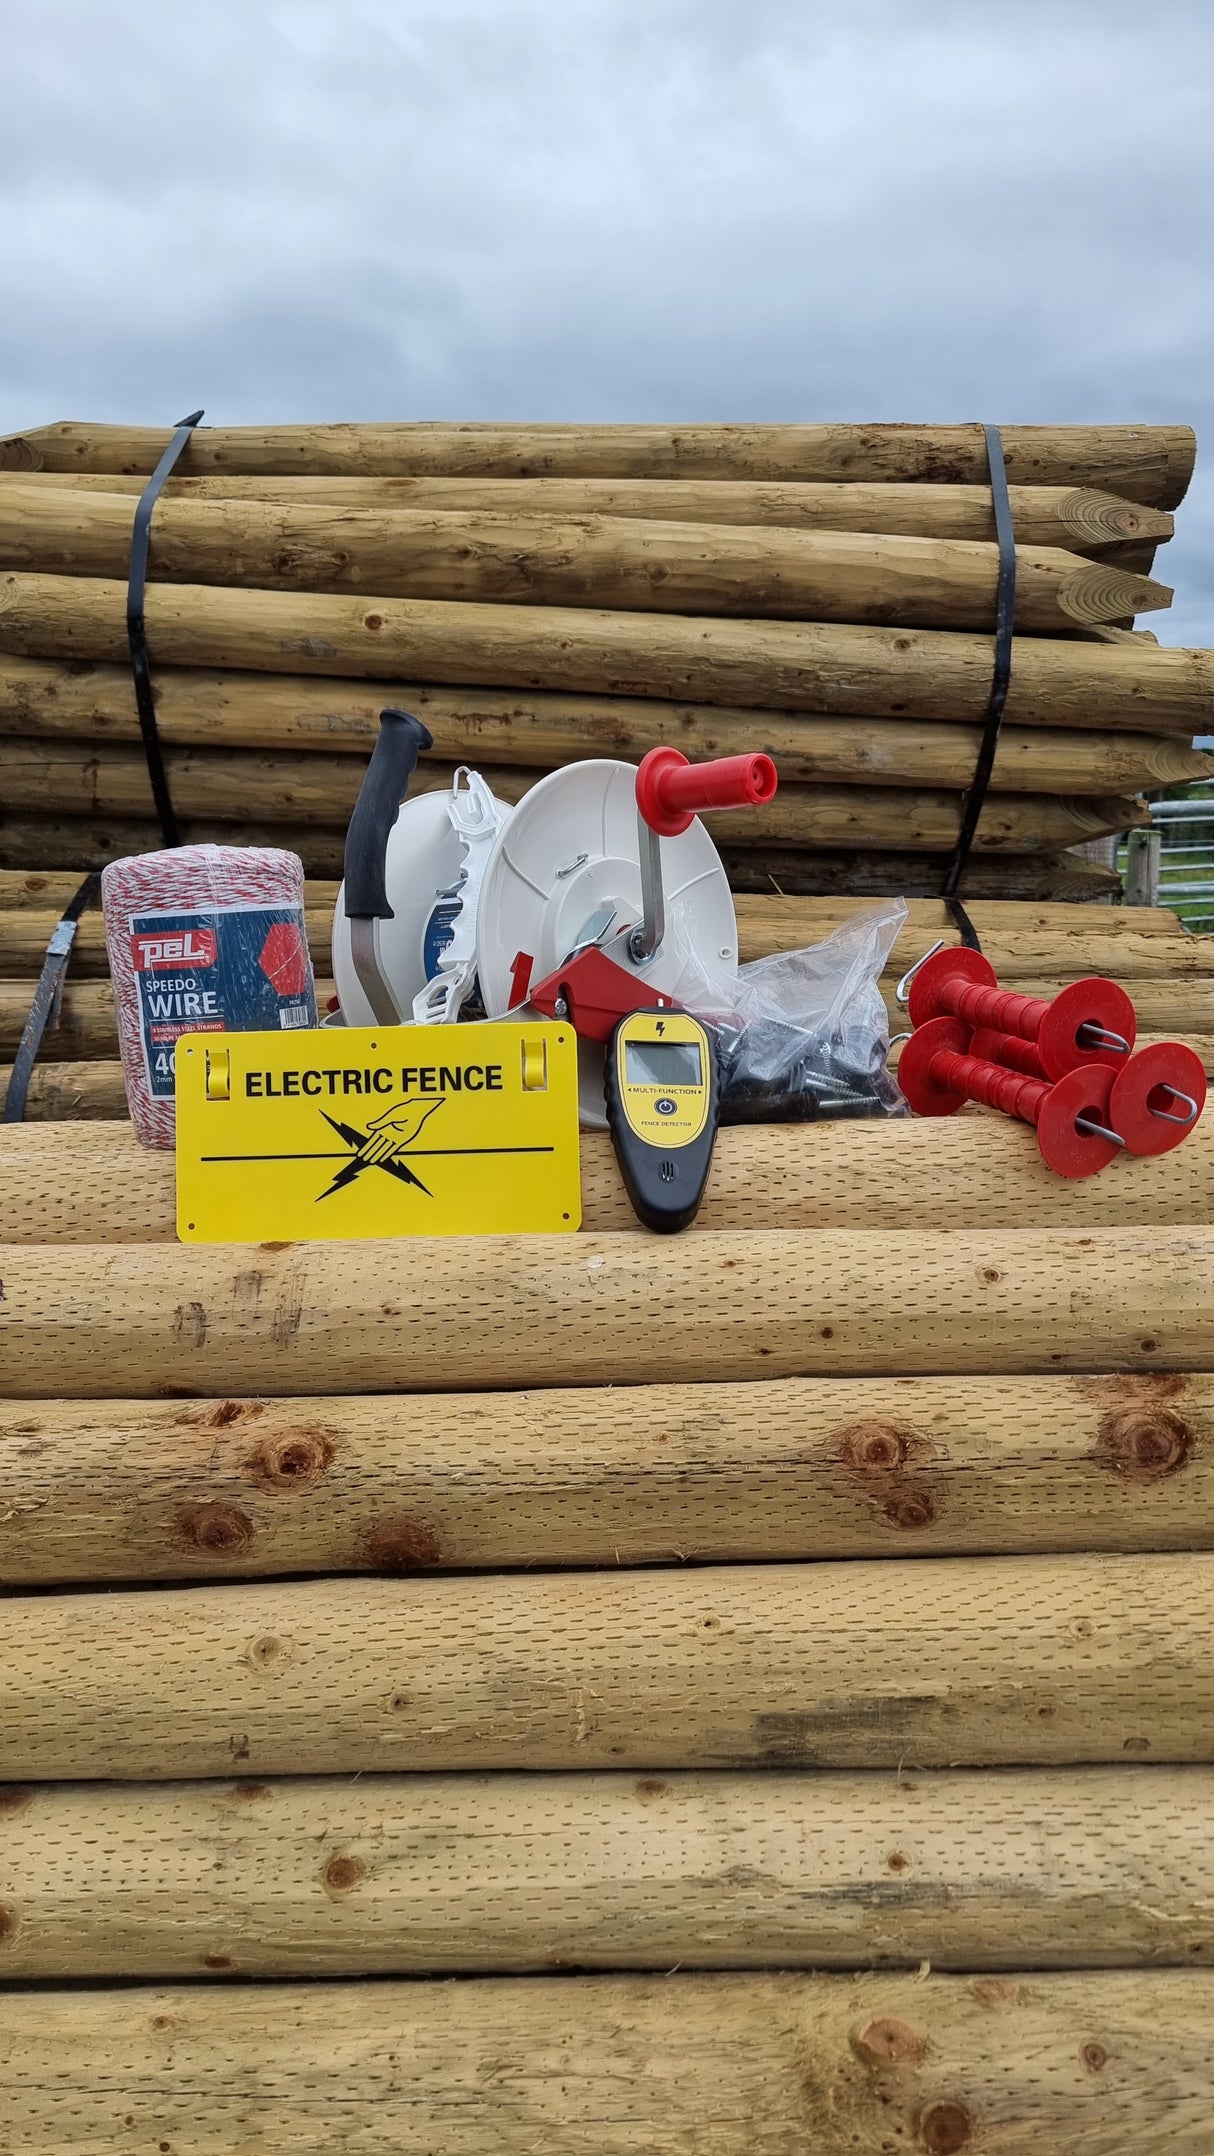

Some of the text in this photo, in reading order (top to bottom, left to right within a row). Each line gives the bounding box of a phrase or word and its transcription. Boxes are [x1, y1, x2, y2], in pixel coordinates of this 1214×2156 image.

[146, 979, 196, 992] SPEEDO
[148, 991, 218, 1017] WIRE
[246, 1065, 503, 1097] ELECTRIC FENCE
